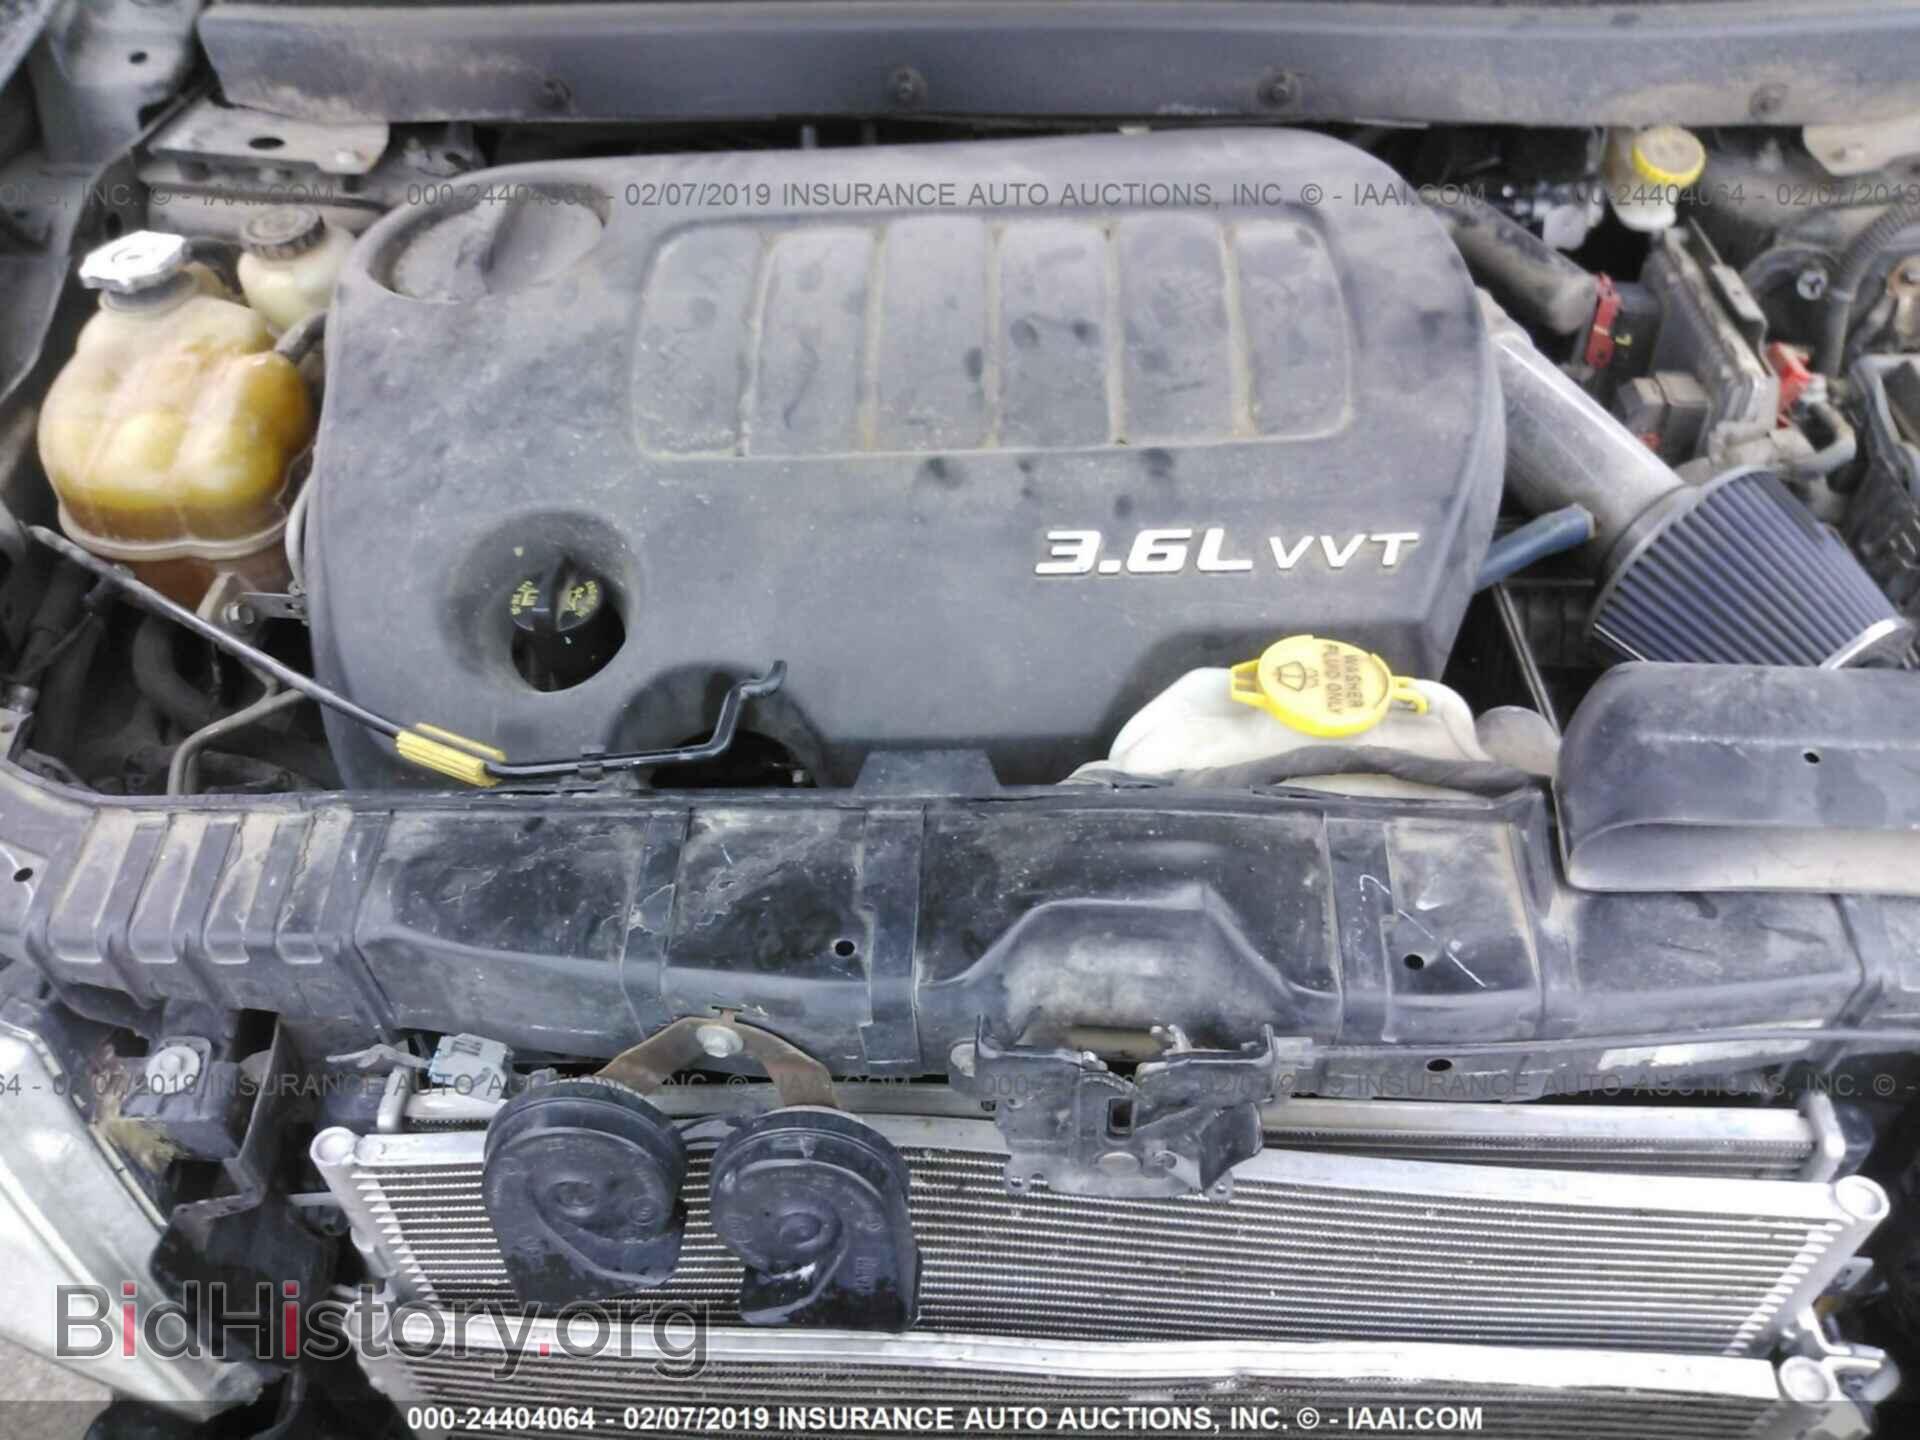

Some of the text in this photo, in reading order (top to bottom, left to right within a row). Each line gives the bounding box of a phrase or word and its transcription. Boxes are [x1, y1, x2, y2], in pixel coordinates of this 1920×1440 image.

[1035, 528, 1419, 574] 3.6L VVT
[1322, 644, 1344, 715] FLUID ONLY
[1345, 655, 1364, 708] WASHER
